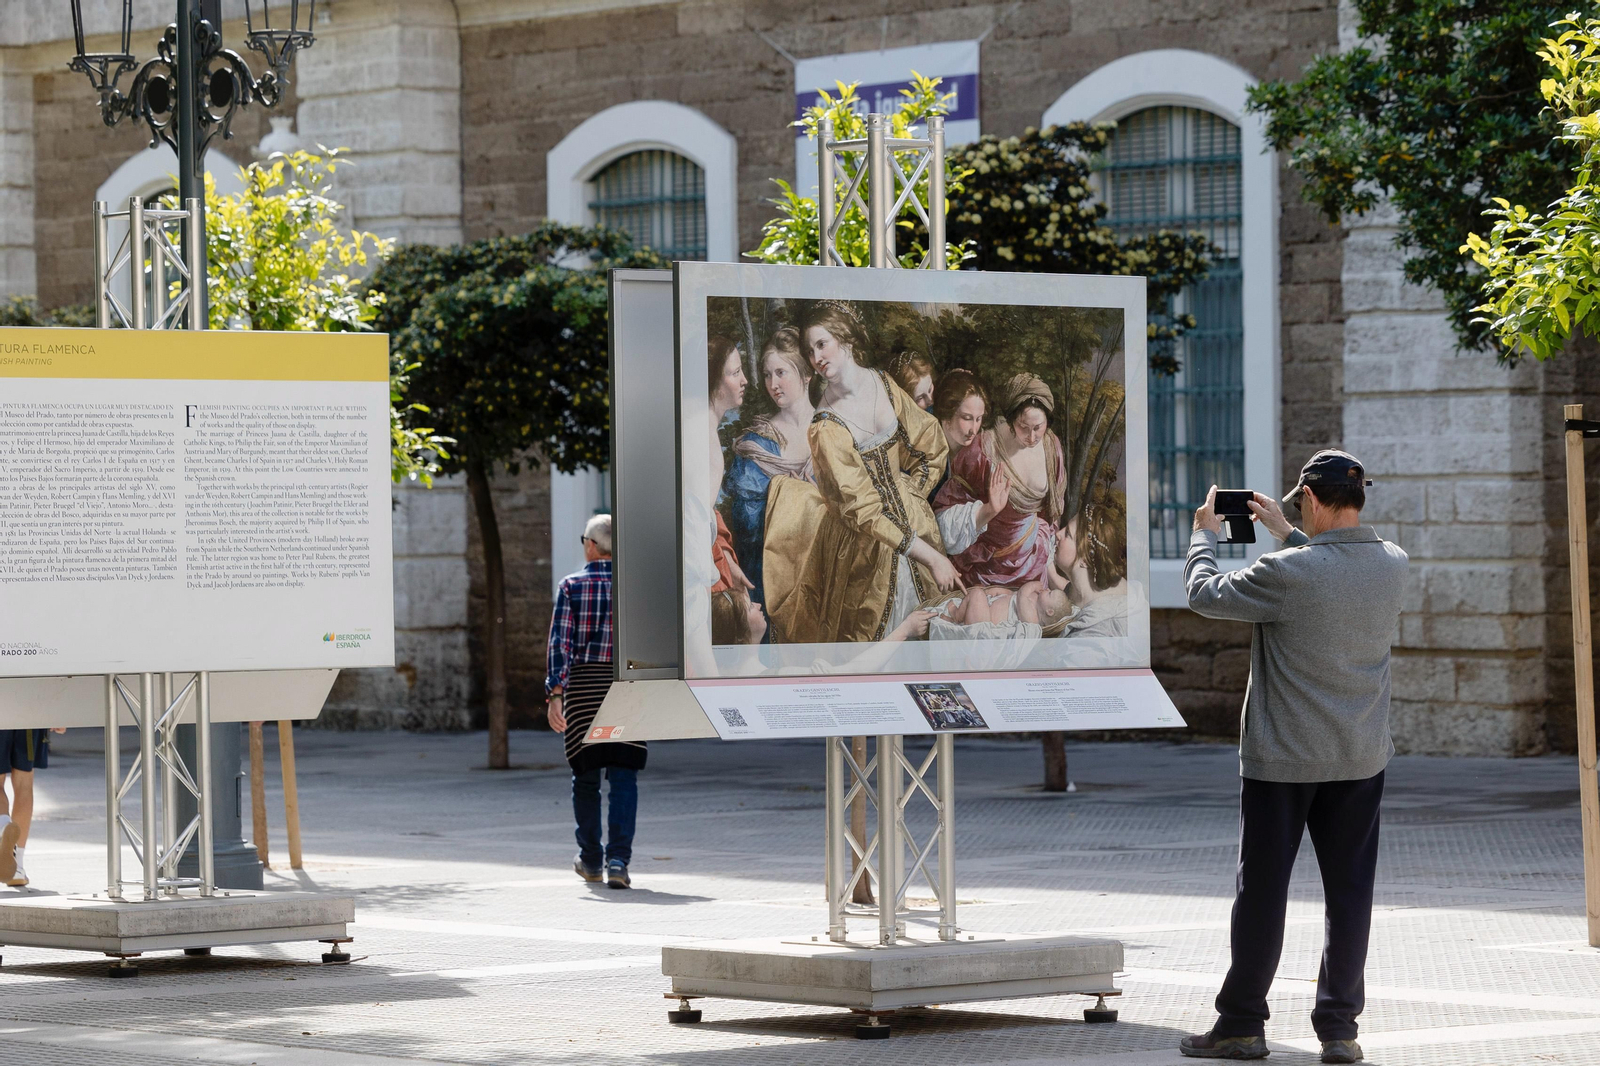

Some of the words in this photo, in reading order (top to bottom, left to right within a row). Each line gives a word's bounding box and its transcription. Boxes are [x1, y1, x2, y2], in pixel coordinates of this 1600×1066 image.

[33, 344, 96, 354] FLAMENCA
[185, 405, 198, 428] F
[210, 430, 235, 439] marriage
[271, 430, 287, 439] Juana
[324, 430, 348, 439] daughter
[17, 438, 35, 447] Felipe
[74, 438, 85, 448] hijo
[97, 438, 128, 448] emperador
[73, 447, 98, 457] propició
[255, 466, 270, 474] point
[60, 483, 91, 493] principales
[130, 483, 143, 493] siglo
[82, 510, 113, 520] adquiridas
[149, 511, 165, 519] parte
[186, 518, 218, 528] Jheronimus
[250, 519, 273, 528] majority
[274, 518, 299, 527] acquired
[308, 518, 325, 527] Philip
[231, 554, 249, 563] region
[349, 553, 370, 562] greatest
[342, 569, 358, 579] pupils
